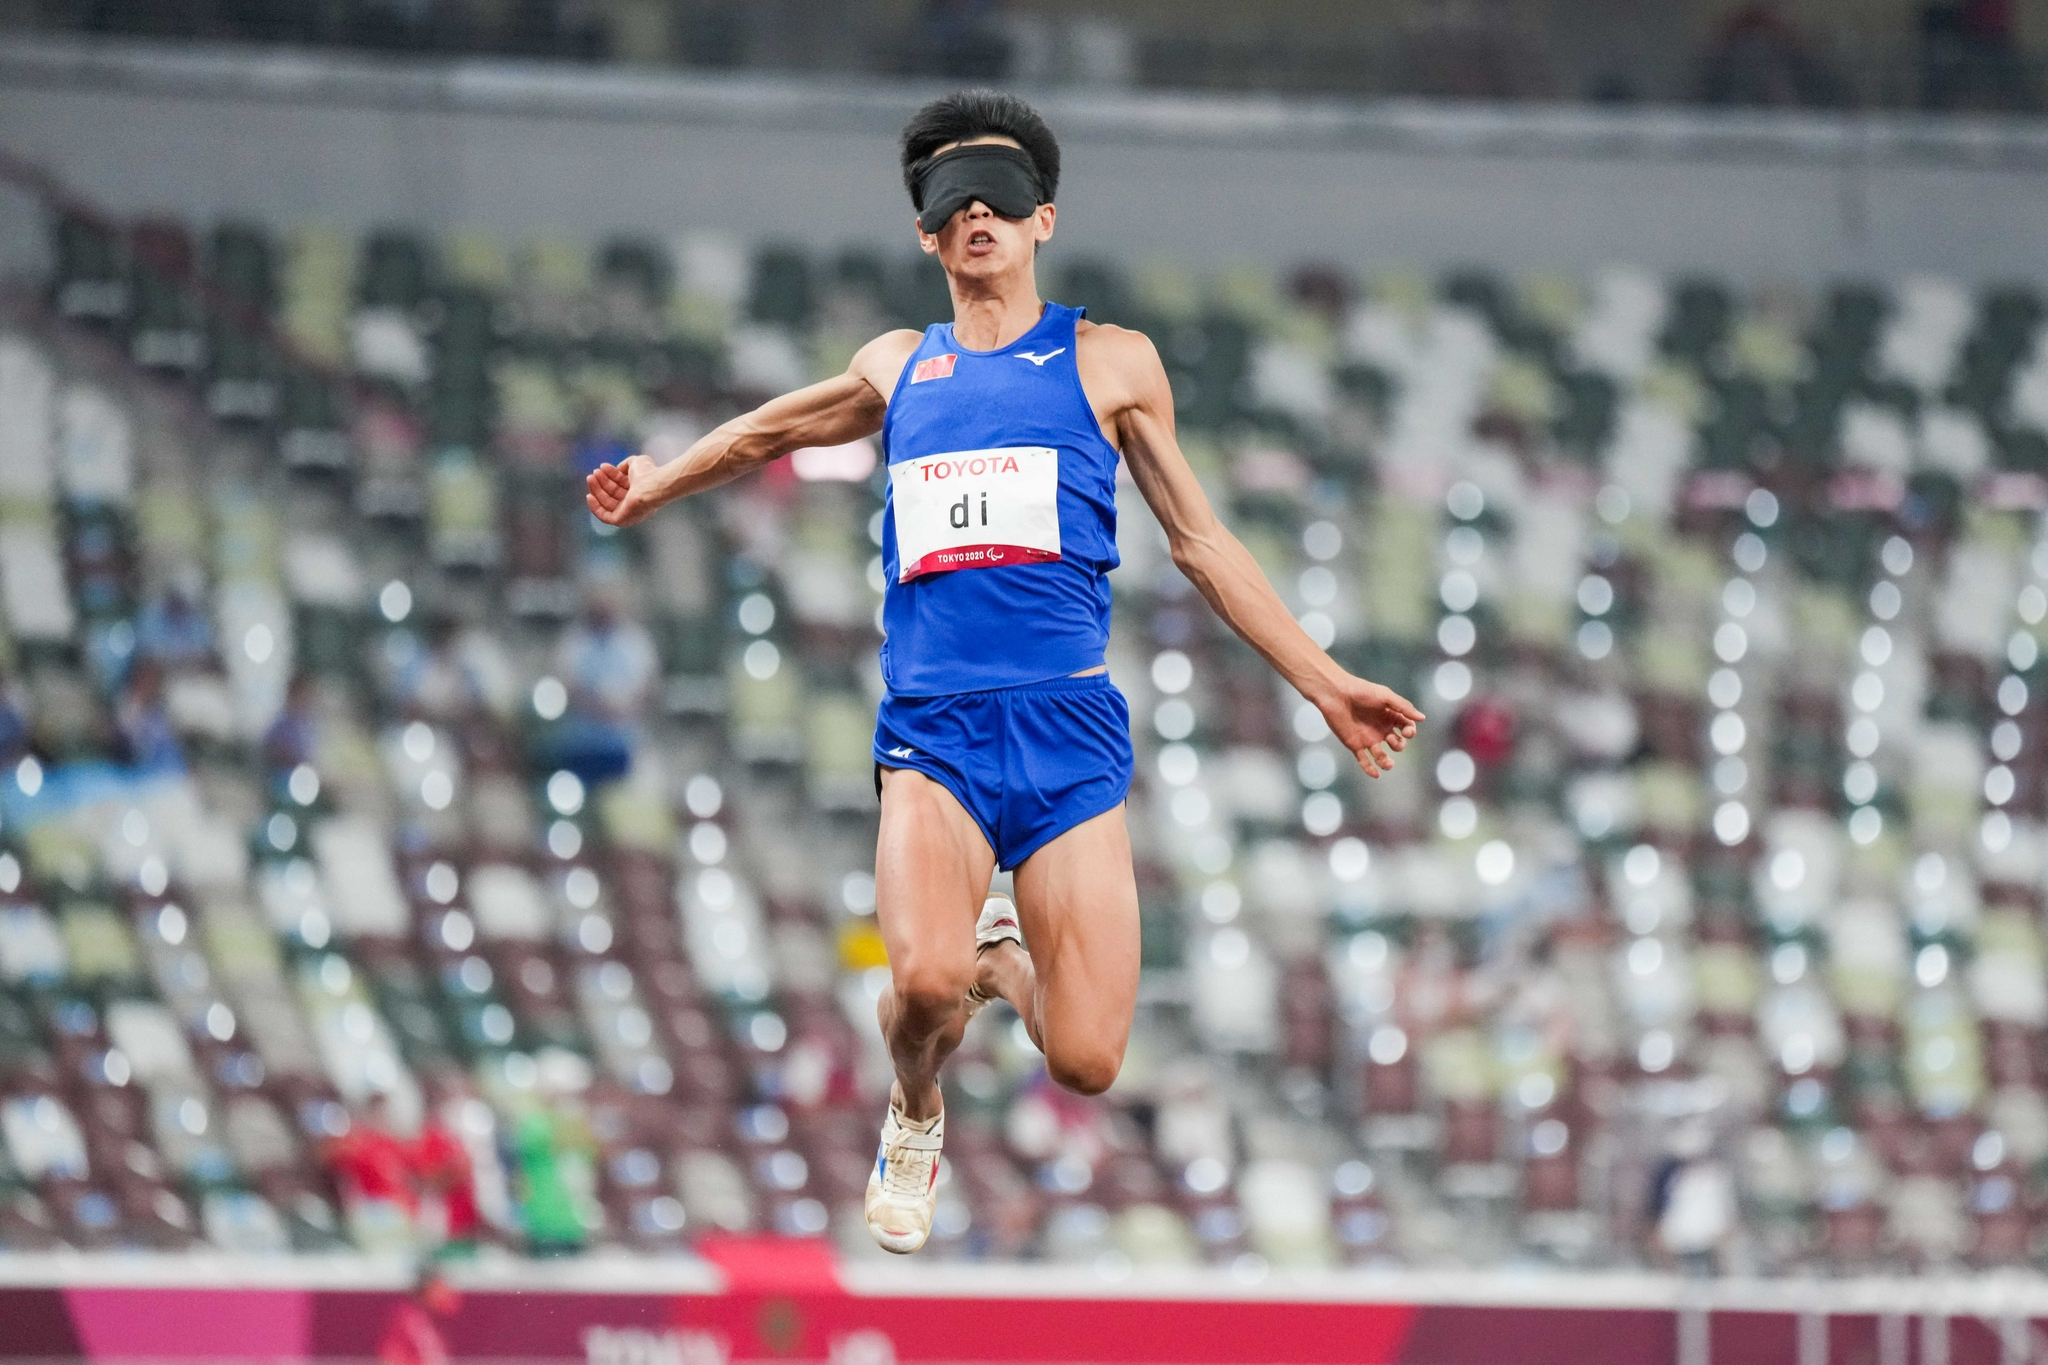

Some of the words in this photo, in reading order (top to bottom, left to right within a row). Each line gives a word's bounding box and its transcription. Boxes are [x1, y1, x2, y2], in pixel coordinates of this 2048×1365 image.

[920, 456, 1019, 481] TOYOTA
[950, 492, 987, 529] di
[938, 553, 964, 563] TOKYO
[965, 551, 984, 561] 2020
